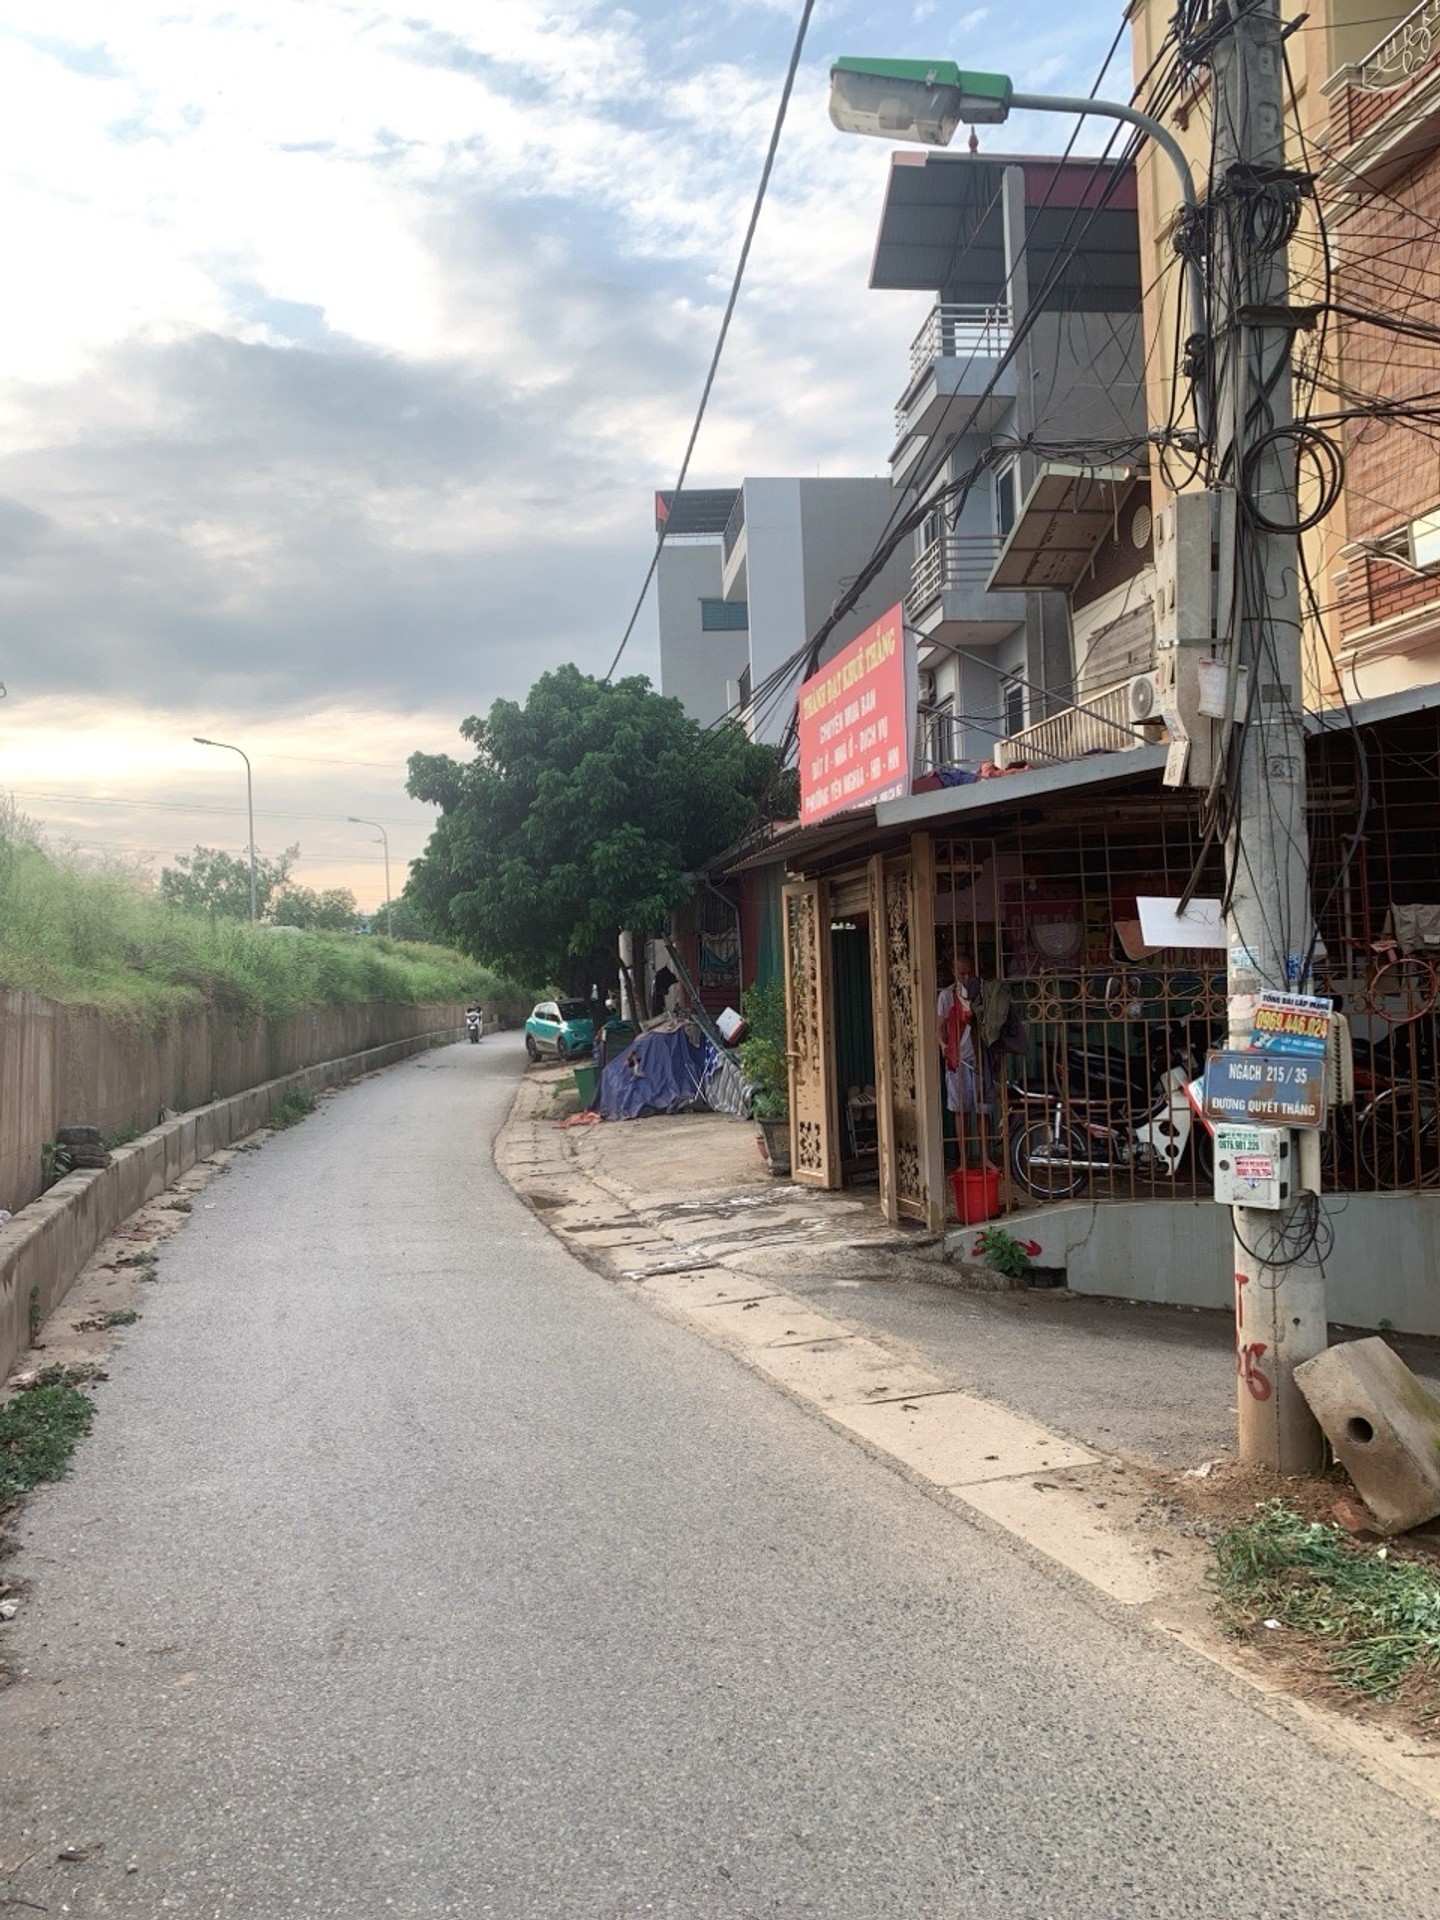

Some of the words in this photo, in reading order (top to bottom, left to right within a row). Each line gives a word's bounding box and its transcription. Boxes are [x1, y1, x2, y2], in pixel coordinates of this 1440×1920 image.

[844, 700, 859, 729] MUA
[877, 715, 888, 743] VỤ
[1228, 1061, 1262, 1081] NGÁCH
[1212, 1095, 1246, 1111] ĐƯỜNG
[1247, 1097, 1279, 1114] QUYẾT
